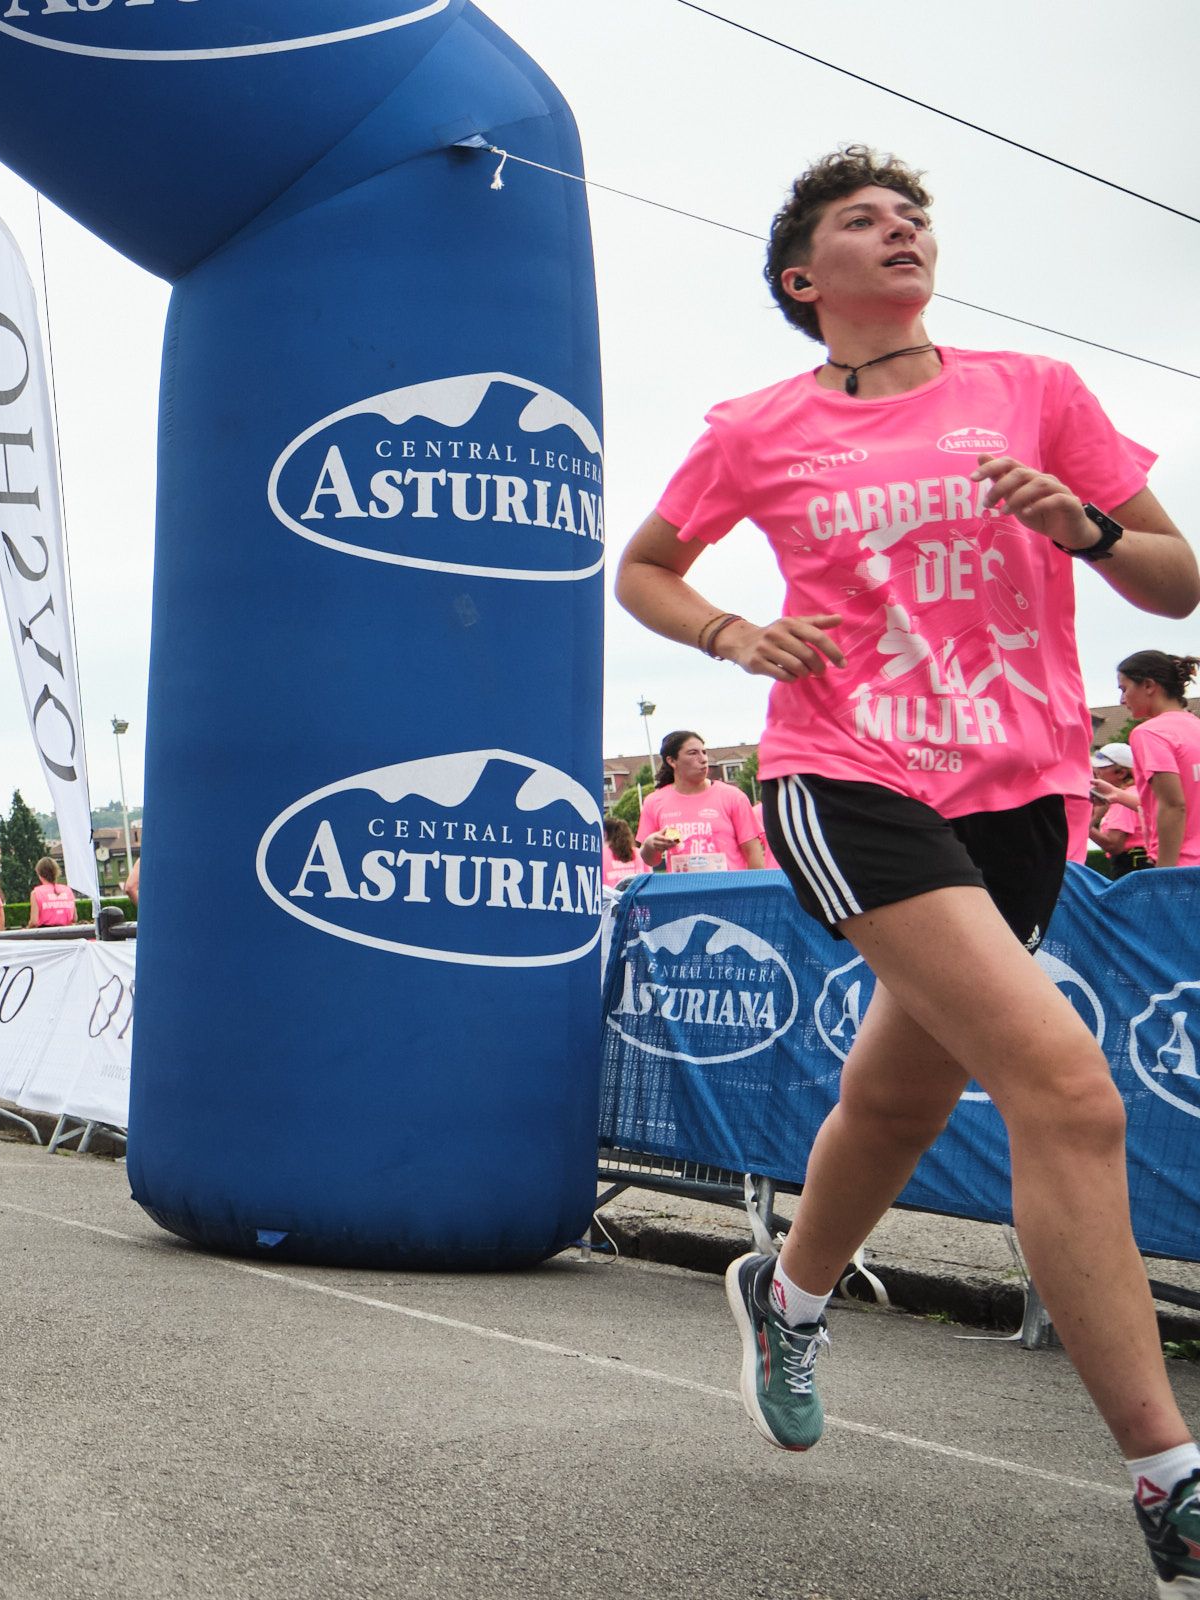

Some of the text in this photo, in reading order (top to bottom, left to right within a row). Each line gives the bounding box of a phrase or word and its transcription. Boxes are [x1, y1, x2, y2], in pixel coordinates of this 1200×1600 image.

[376, 440, 517, 463] CENTRAL
[787, 448, 869, 479] OYSHO
[806, 475, 1000, 541] CARRERA
[915, 537, 976, 603] DE
[852, 696, 1008, 745] MUJER
[907, 748, 963, 773] 2026
[368, 818, 513, 844] CENTRAL
[289, 820, 602, 915] ASTURIANA
